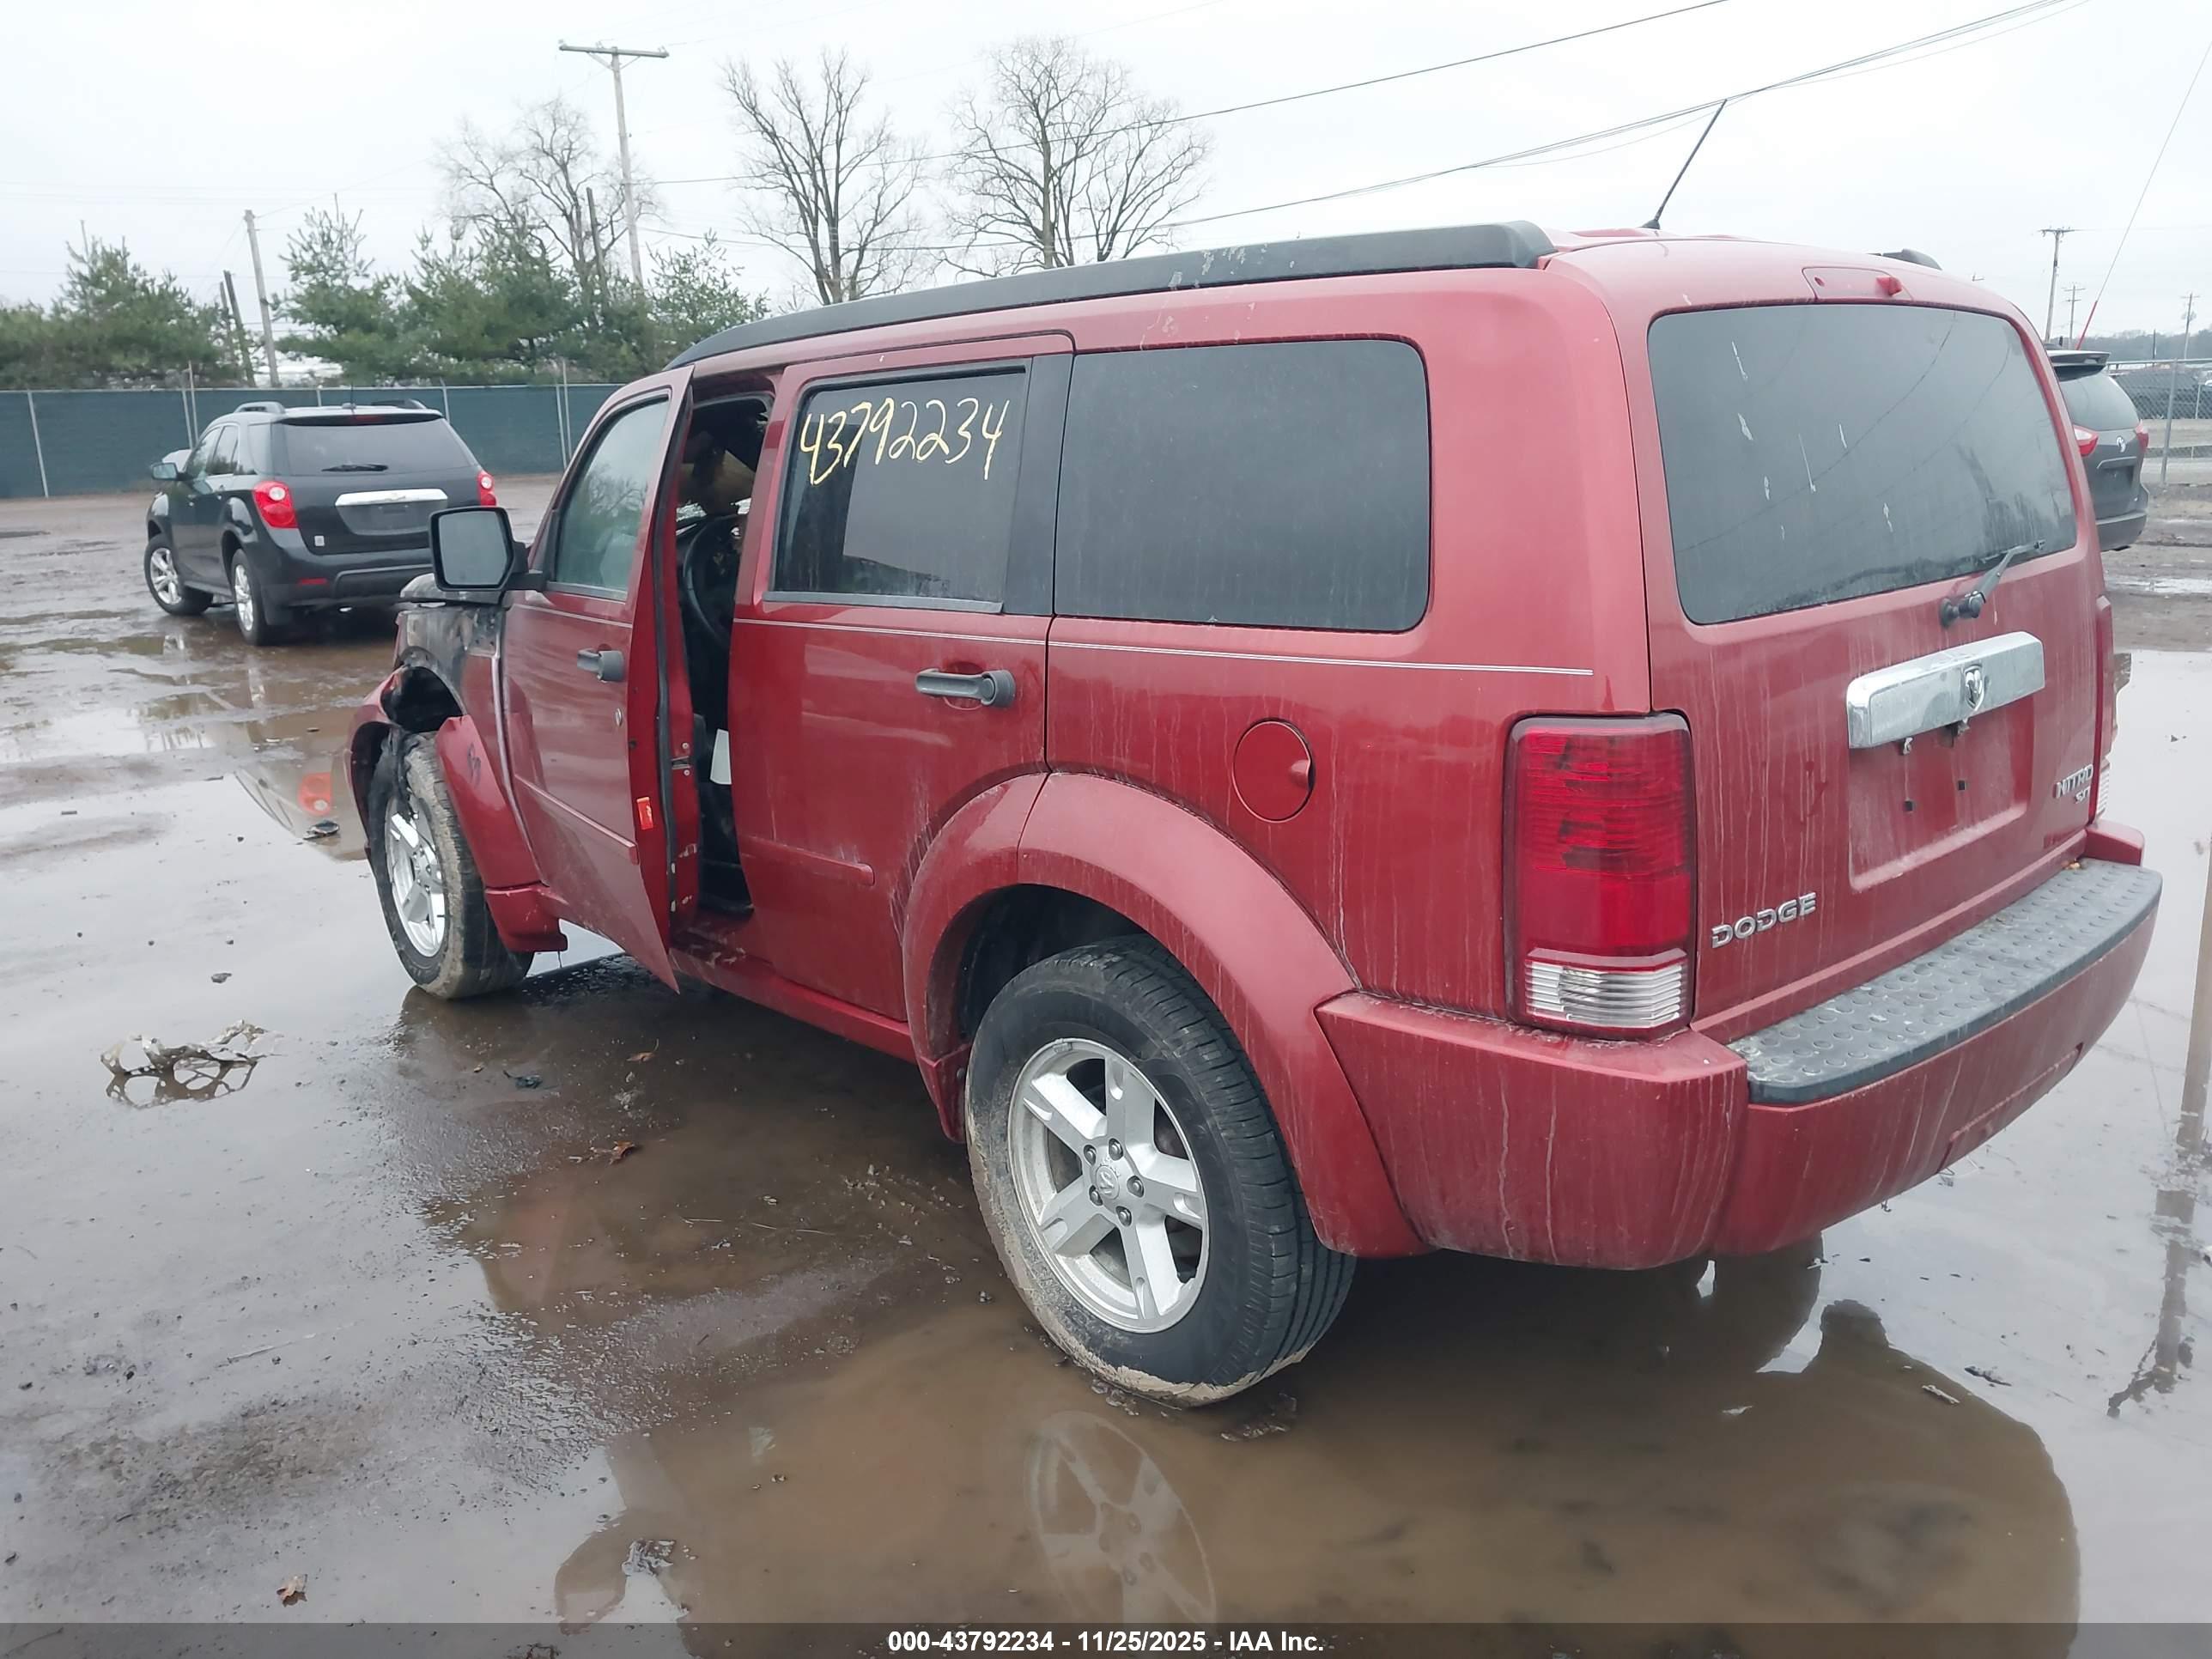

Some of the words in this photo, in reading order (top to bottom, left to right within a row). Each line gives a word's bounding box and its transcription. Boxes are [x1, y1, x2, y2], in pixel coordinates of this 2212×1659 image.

[800, 397, 1010, 485] 43792234
[2055, 763, 2094, 799] NITRO
[1711, 891, 1817, 949] DODGE
